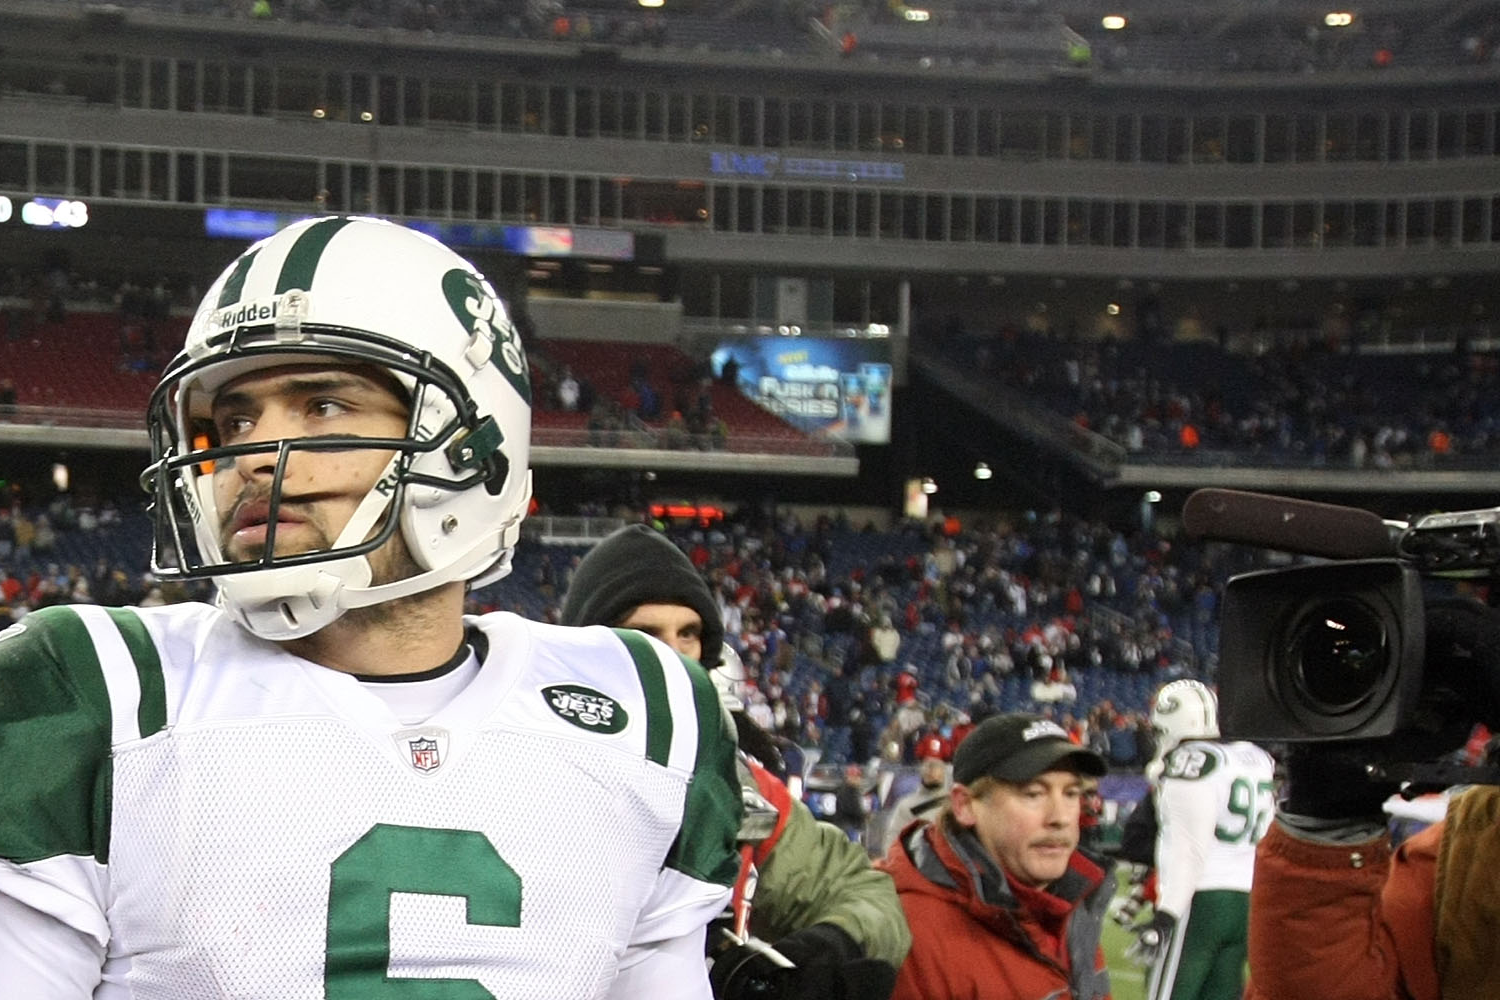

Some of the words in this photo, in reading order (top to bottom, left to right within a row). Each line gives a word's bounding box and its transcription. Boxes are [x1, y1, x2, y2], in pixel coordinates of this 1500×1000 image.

[221, 300, 283, 328] Riddel
[552, 695, 614, 719] JETS
[412, 751, 439, 767] NFL
